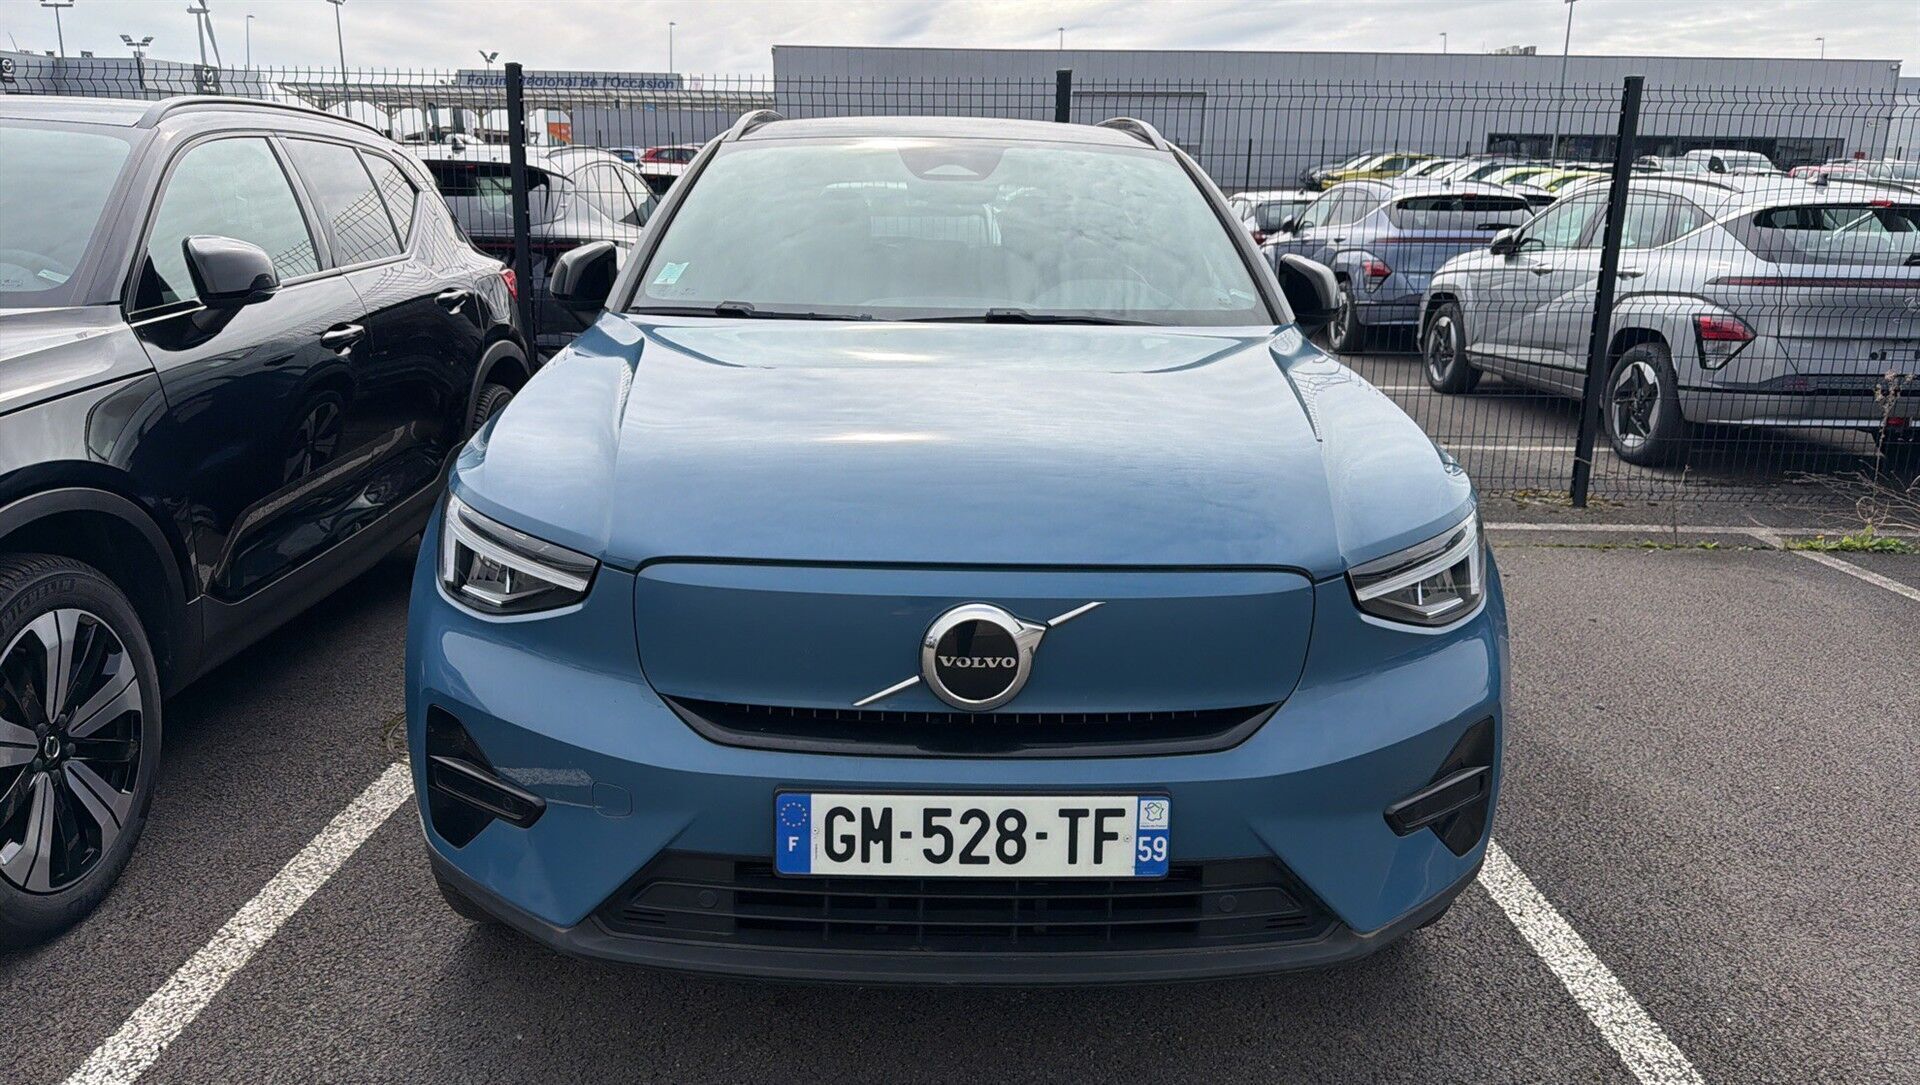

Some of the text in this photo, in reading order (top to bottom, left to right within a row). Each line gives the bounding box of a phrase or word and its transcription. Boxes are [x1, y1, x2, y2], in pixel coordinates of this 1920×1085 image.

[582, 76, 598, 87] de
[603, 76, 674, 89] l'Occasion
[937, 655, 1017, 668] VOLVO
[824, 806, 1126, 864] GM-528-TF
[788, 836, 799, 852] F
[1138, 836, 1168, 862] 59
